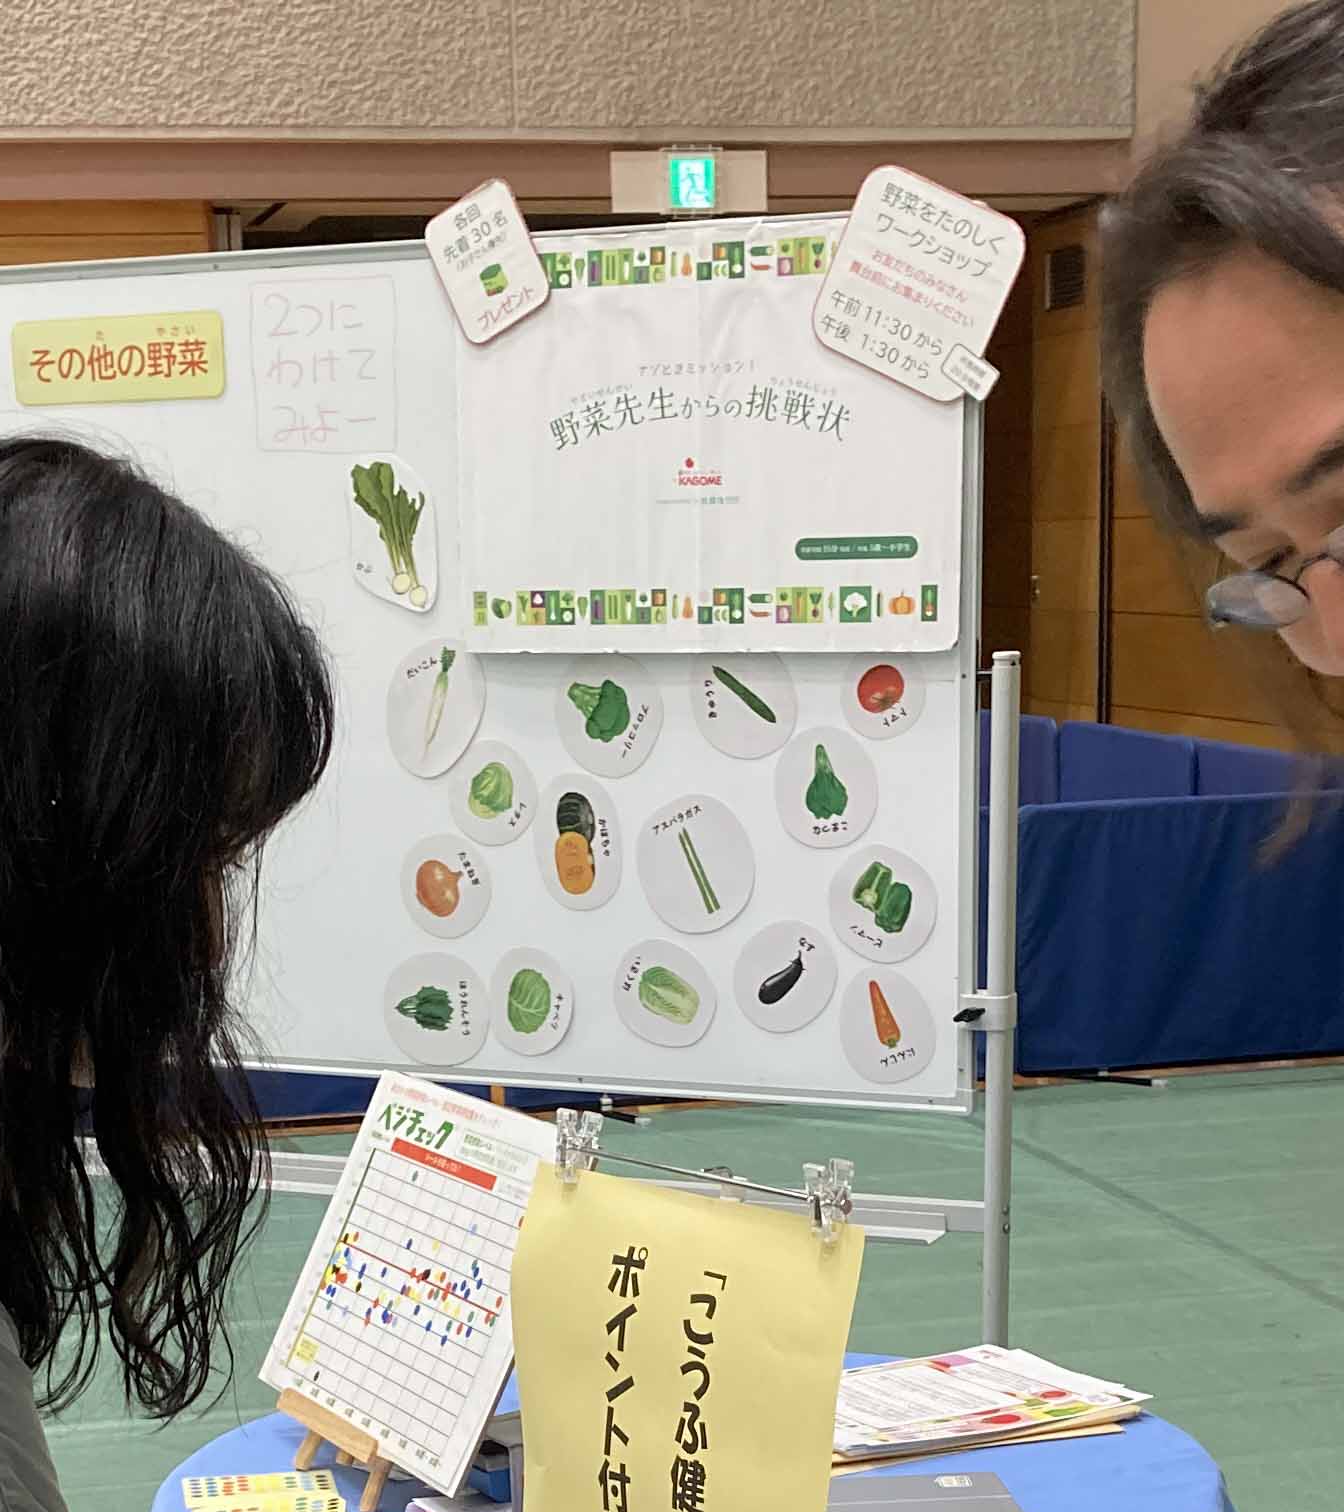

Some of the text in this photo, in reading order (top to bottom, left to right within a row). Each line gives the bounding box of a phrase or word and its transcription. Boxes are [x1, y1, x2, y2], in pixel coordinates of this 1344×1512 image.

[880, 182, 1006, 255] 野菜をたのしく
[876, 213, 993, 277] ワークショップ
[267, 295, 364, 338] 2つに
[478, 286, 534, 332] プレゼント
[29, 338, 209, 383] その他の野菜
[266, 347, 377, 389] わけて
[549, 384, 850, 451] 野菜先生からの挑戦状
[677, 475, 722, 487] KAGOME
[406, 656, 438, 679] だいこん
[621, 703, 650, 759] ブロッコリー
[882, 707, 907, 728] トマト
[651, 804, 703, 836] アスパラガス
[798, 937, 816, 952] なす
[376, 1101, 458, 1150] ベジチェック
